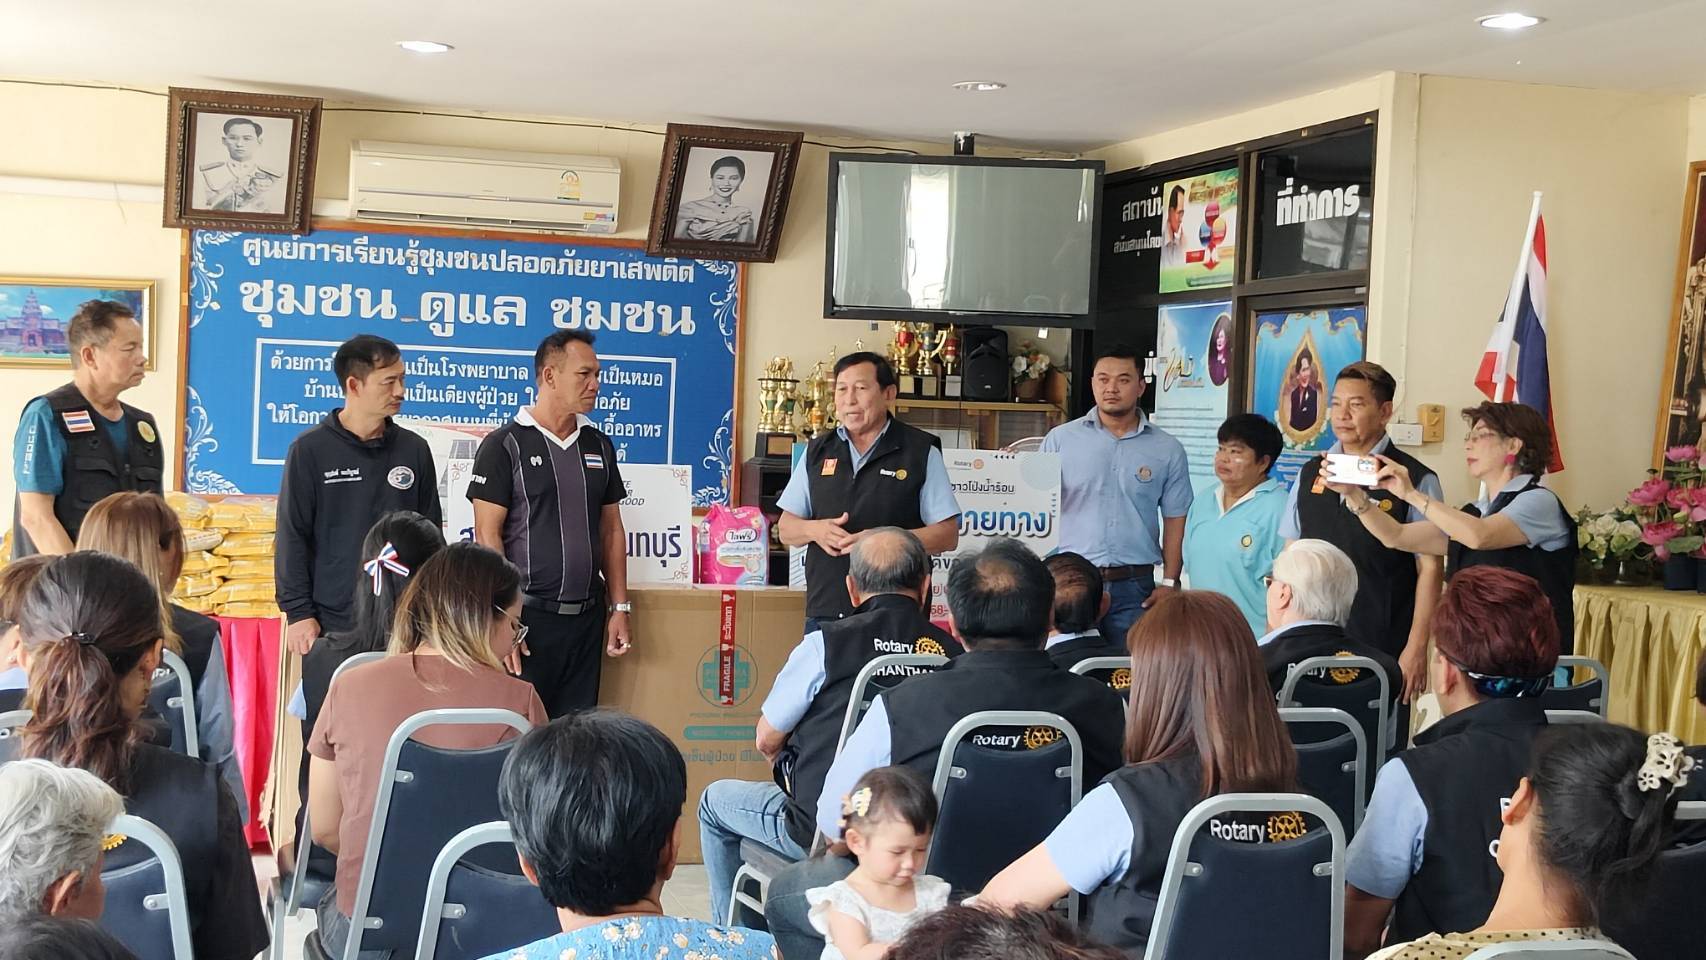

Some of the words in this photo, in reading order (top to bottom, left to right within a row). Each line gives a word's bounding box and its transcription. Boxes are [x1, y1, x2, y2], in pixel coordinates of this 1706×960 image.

[1276, 177, 1360, 226] ที่ทำการ
[239, 279, 398, 328] ชุมชน
[420, 291, 527, 337] ดูแล
[551, 296, 696, 336] ชมชน
[873, 638, 914, 655] Rotary
[723, 655, 732, 692] FRAGILE
[972, 734, 1021, 748] Rotary
[1210, 818, 1266, 844] Rotary
